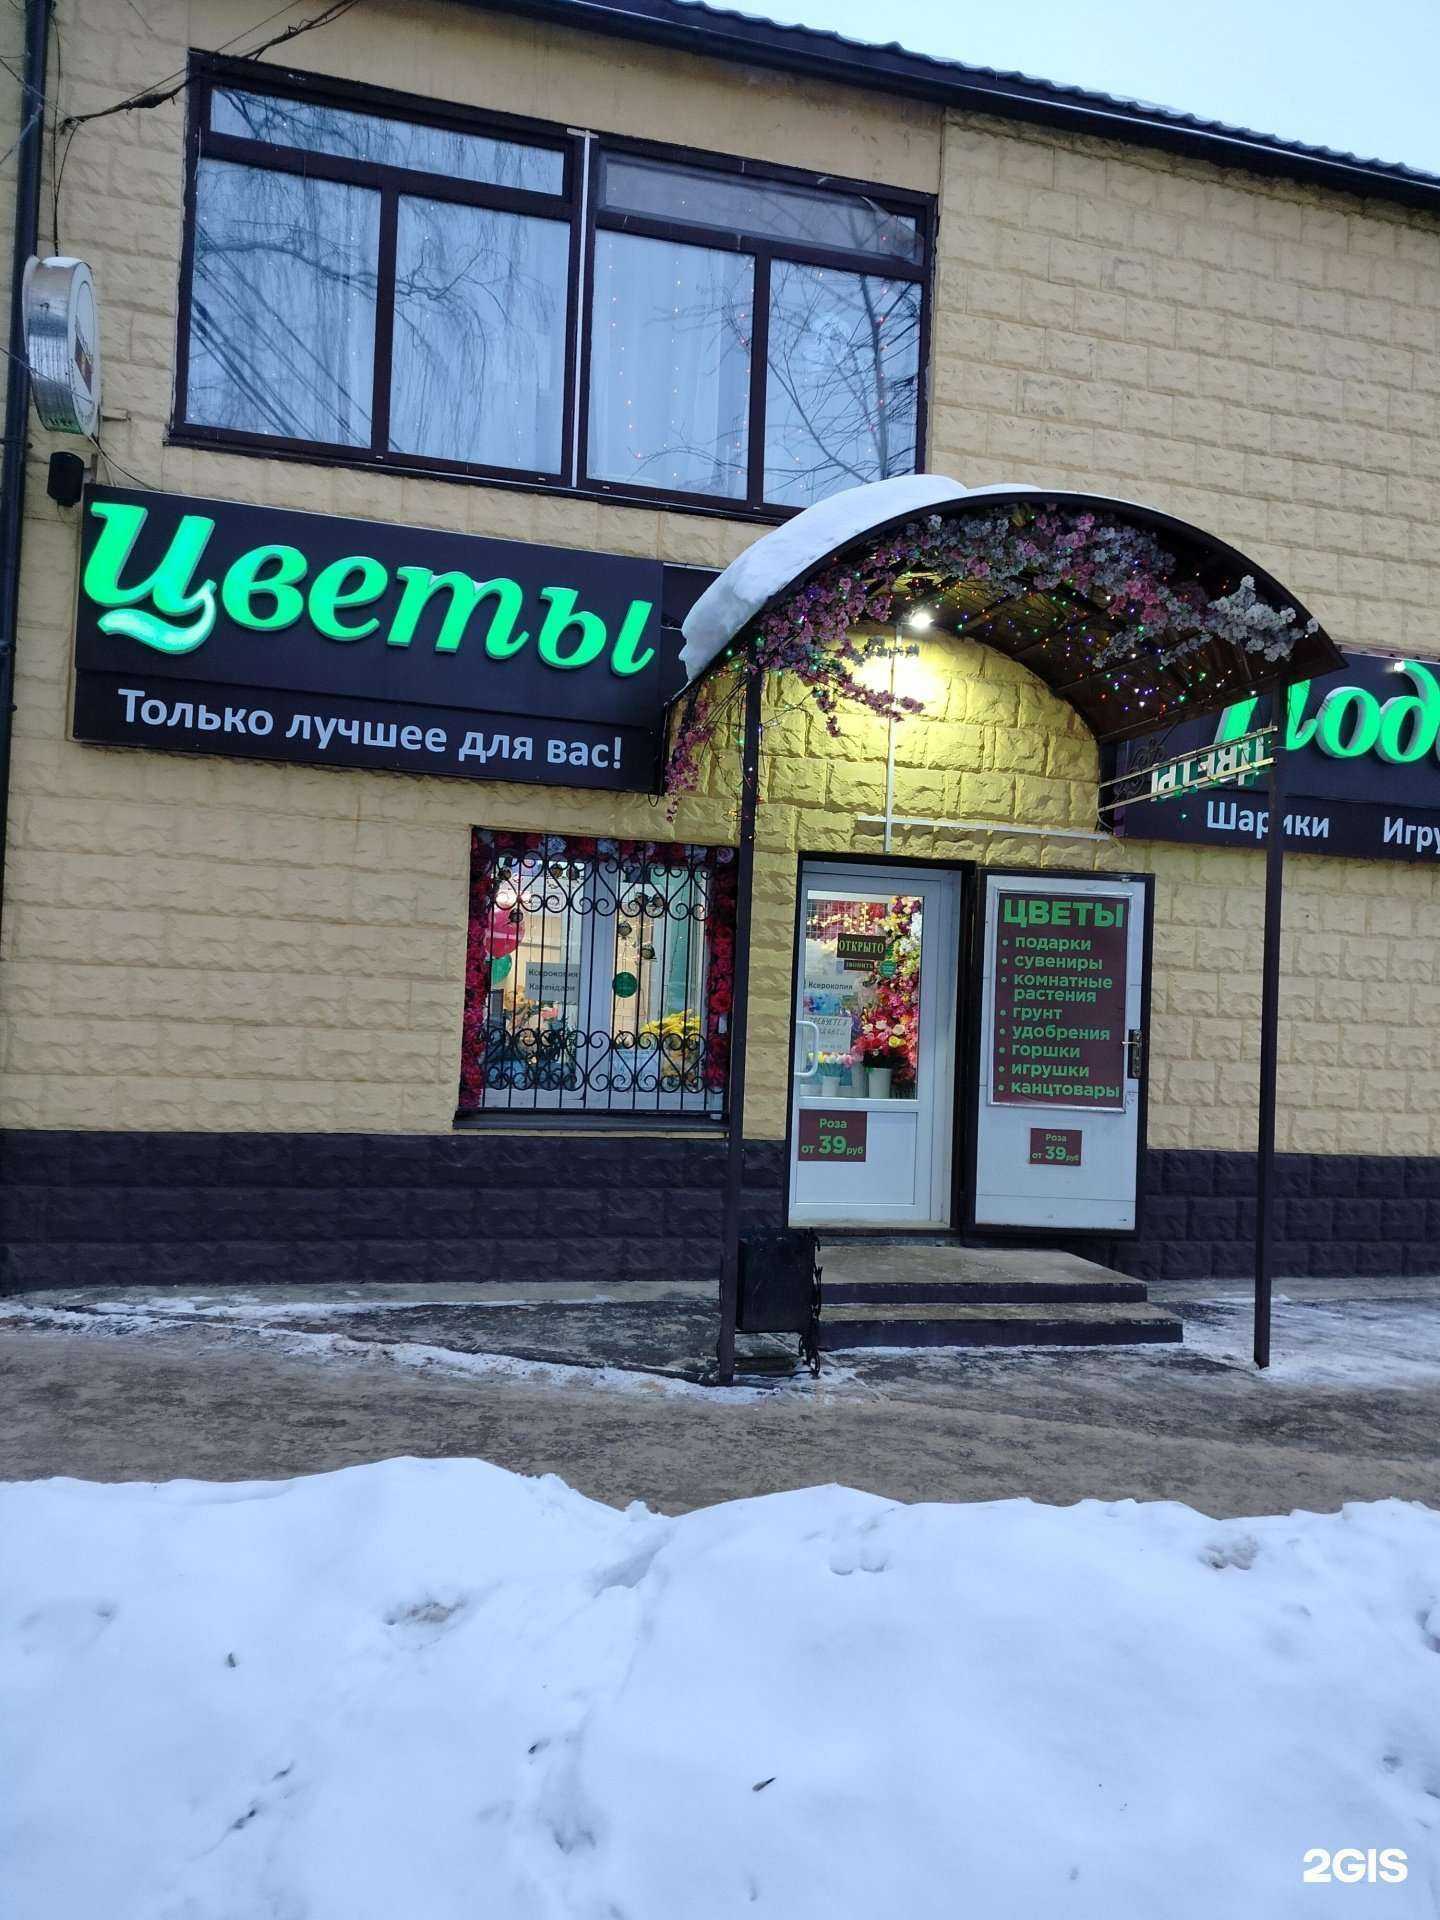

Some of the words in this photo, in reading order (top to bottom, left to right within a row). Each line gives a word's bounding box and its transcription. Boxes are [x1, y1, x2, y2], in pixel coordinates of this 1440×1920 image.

[83, 501, 656, 677] Цветы
[118, 688, 274, 736] Только
[286, 714, 447, 753] лучшее
[458, 731, 533, 764] для
[547, 736, 622, 769] вас!
[1207, 800, 1330, 839] Шарики
[1003, 899, 1125, 929] ЦВЕТЫ
[838, 940, 884, 954] ОТКРЫТО
[1015, 936, 1092, 952] подарки
[1014, 955, 1103, 971] сувениры
[1014, 974, 1113, 989] комнатные
[1014, 988, 1097, 1003] растения
[1013, 1007, 1063, 1021] грунт
[1012, 1024, 1111, 1041] удобрения
[1012, 1044, 1081, 1059] горшки
[1011, 1063, 1090, 1078] игрушки
[1011, 1081, 1121, 1098] канцтовары
[819, 1118, 848, 1129] Роза
[801, 1145, 815, 1154] от
[818, 1135, 847, 1154] 39
[846, 1146, 864, 1156] руб
[1045, 1146, 1067, 1160] 39
